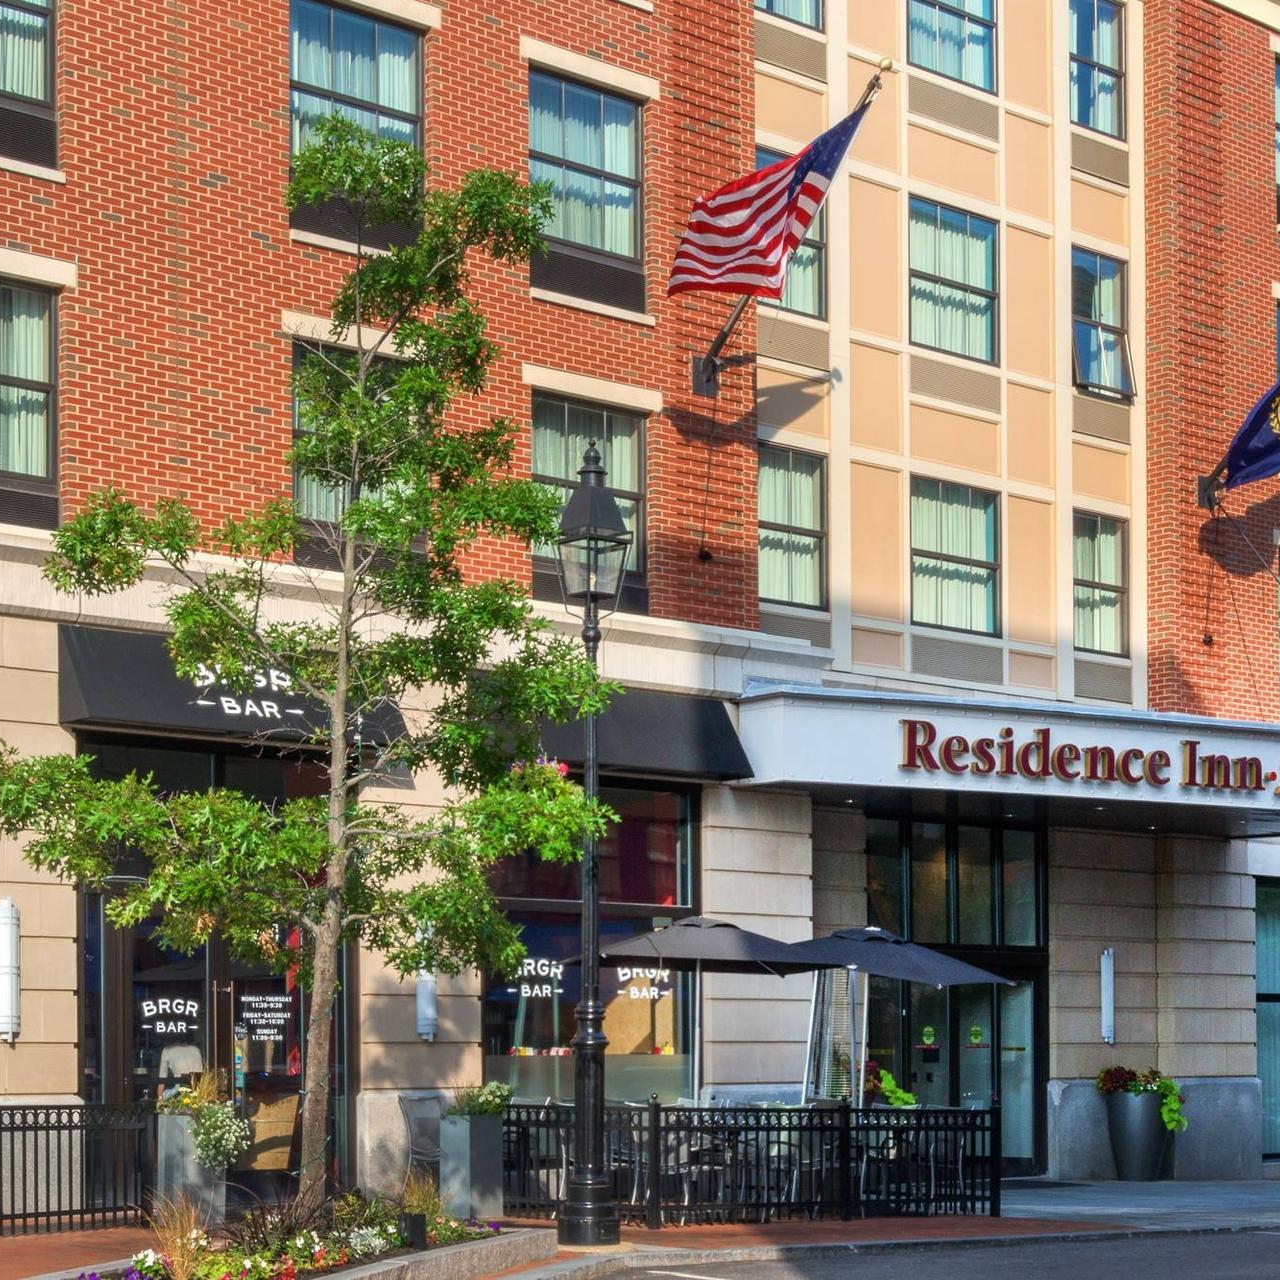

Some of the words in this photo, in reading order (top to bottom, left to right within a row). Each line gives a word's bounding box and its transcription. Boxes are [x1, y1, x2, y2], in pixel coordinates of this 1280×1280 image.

[220, 696, 282, 719] BAR
[897, 718, 1171, 787] Residence
[1179, 739, 1266, 792] Inn
[515, 958, 564, 980] RGR
[521, 984, 552, 998] BAR
[629, 987, 659, 1000] BAR
[142, 998, 199, 1017] BRGR
[156, 1021, 187, 1033] BAR
